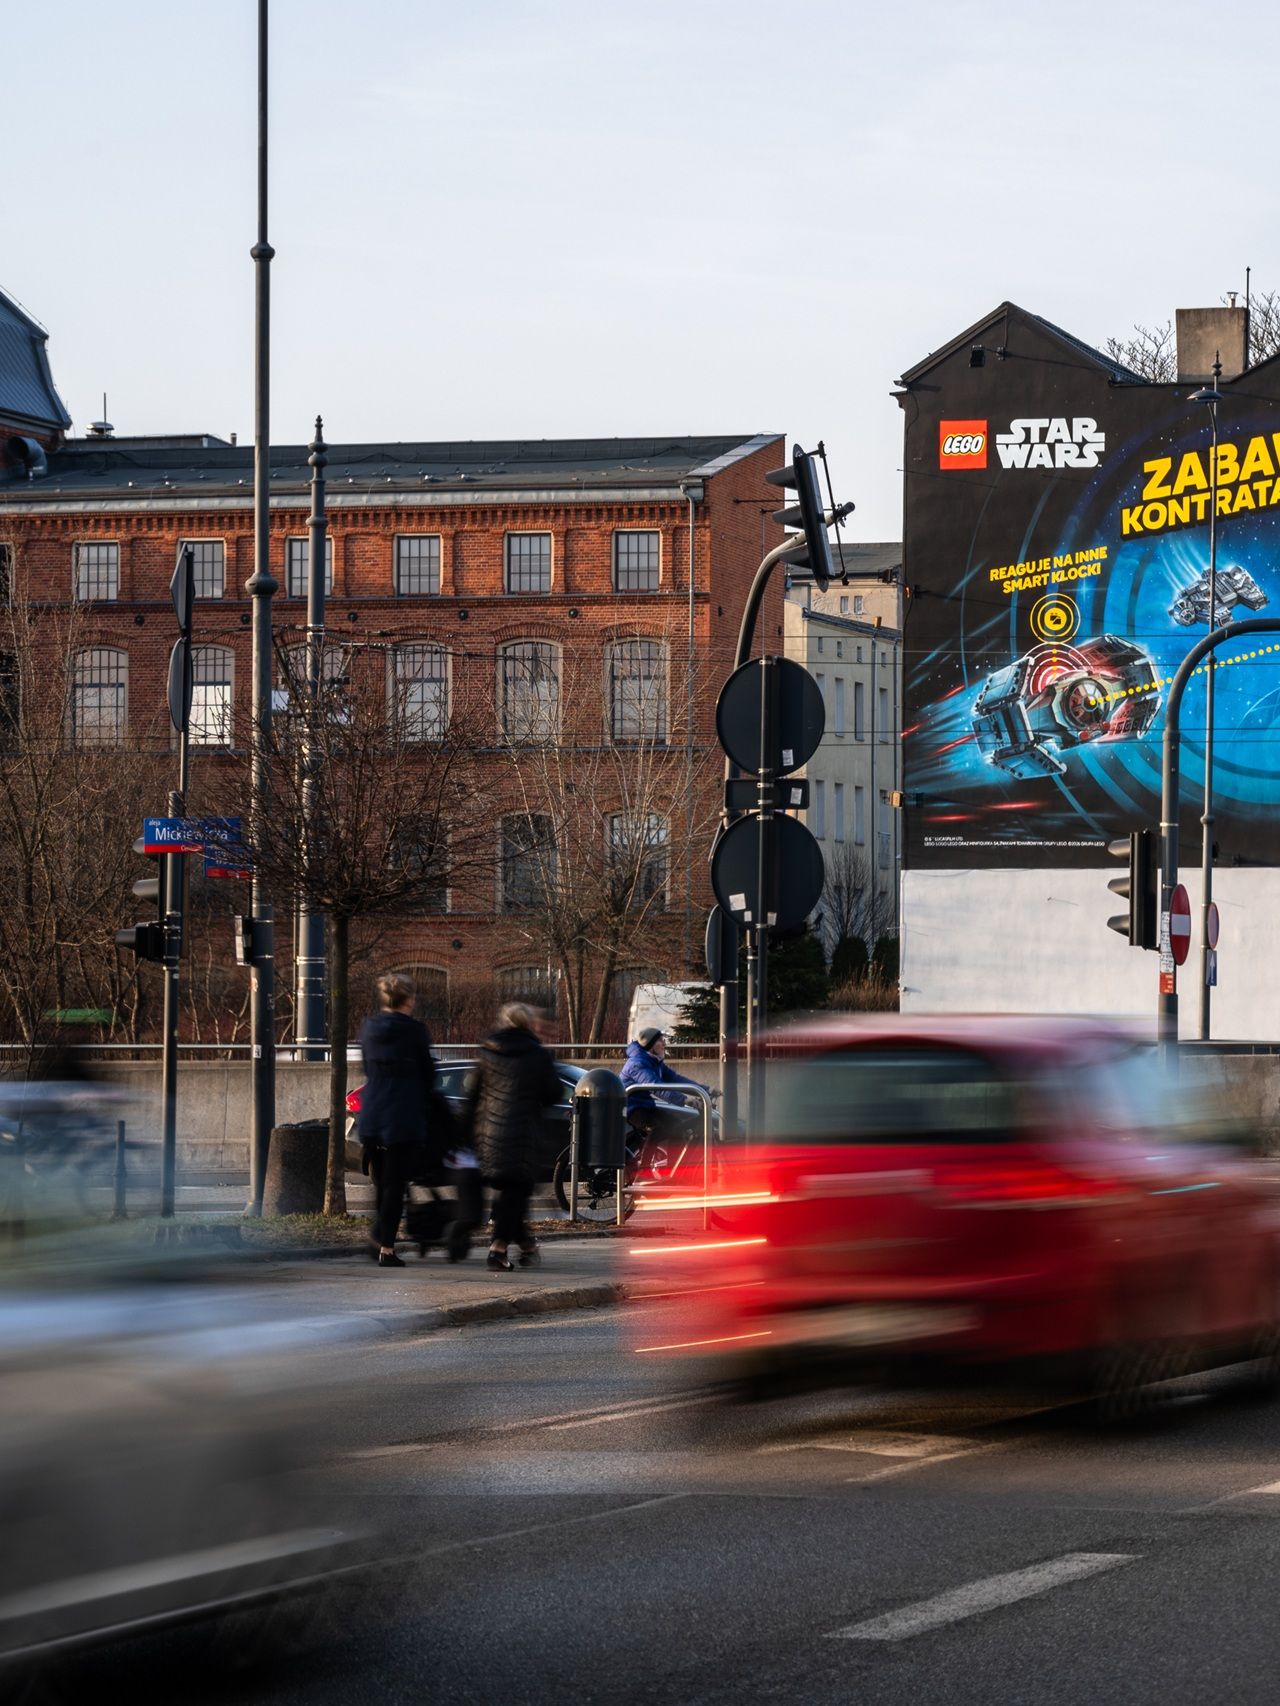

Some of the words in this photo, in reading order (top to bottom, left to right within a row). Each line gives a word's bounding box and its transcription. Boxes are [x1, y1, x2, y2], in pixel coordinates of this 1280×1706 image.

[996, 418, 1105, 443] STAR
[942, 434, 985, 455] LEGO
[996, 443, 1105, 468] WARS
[990, 558, 1051, 581] REAGUJE
[1053, 554, 1073, 568] NA
[1075, 546, 1107, 564] INNE
[1003, 573, 1050, 594] SMART
[1051, 562, 1101, 583] KLOCKI
